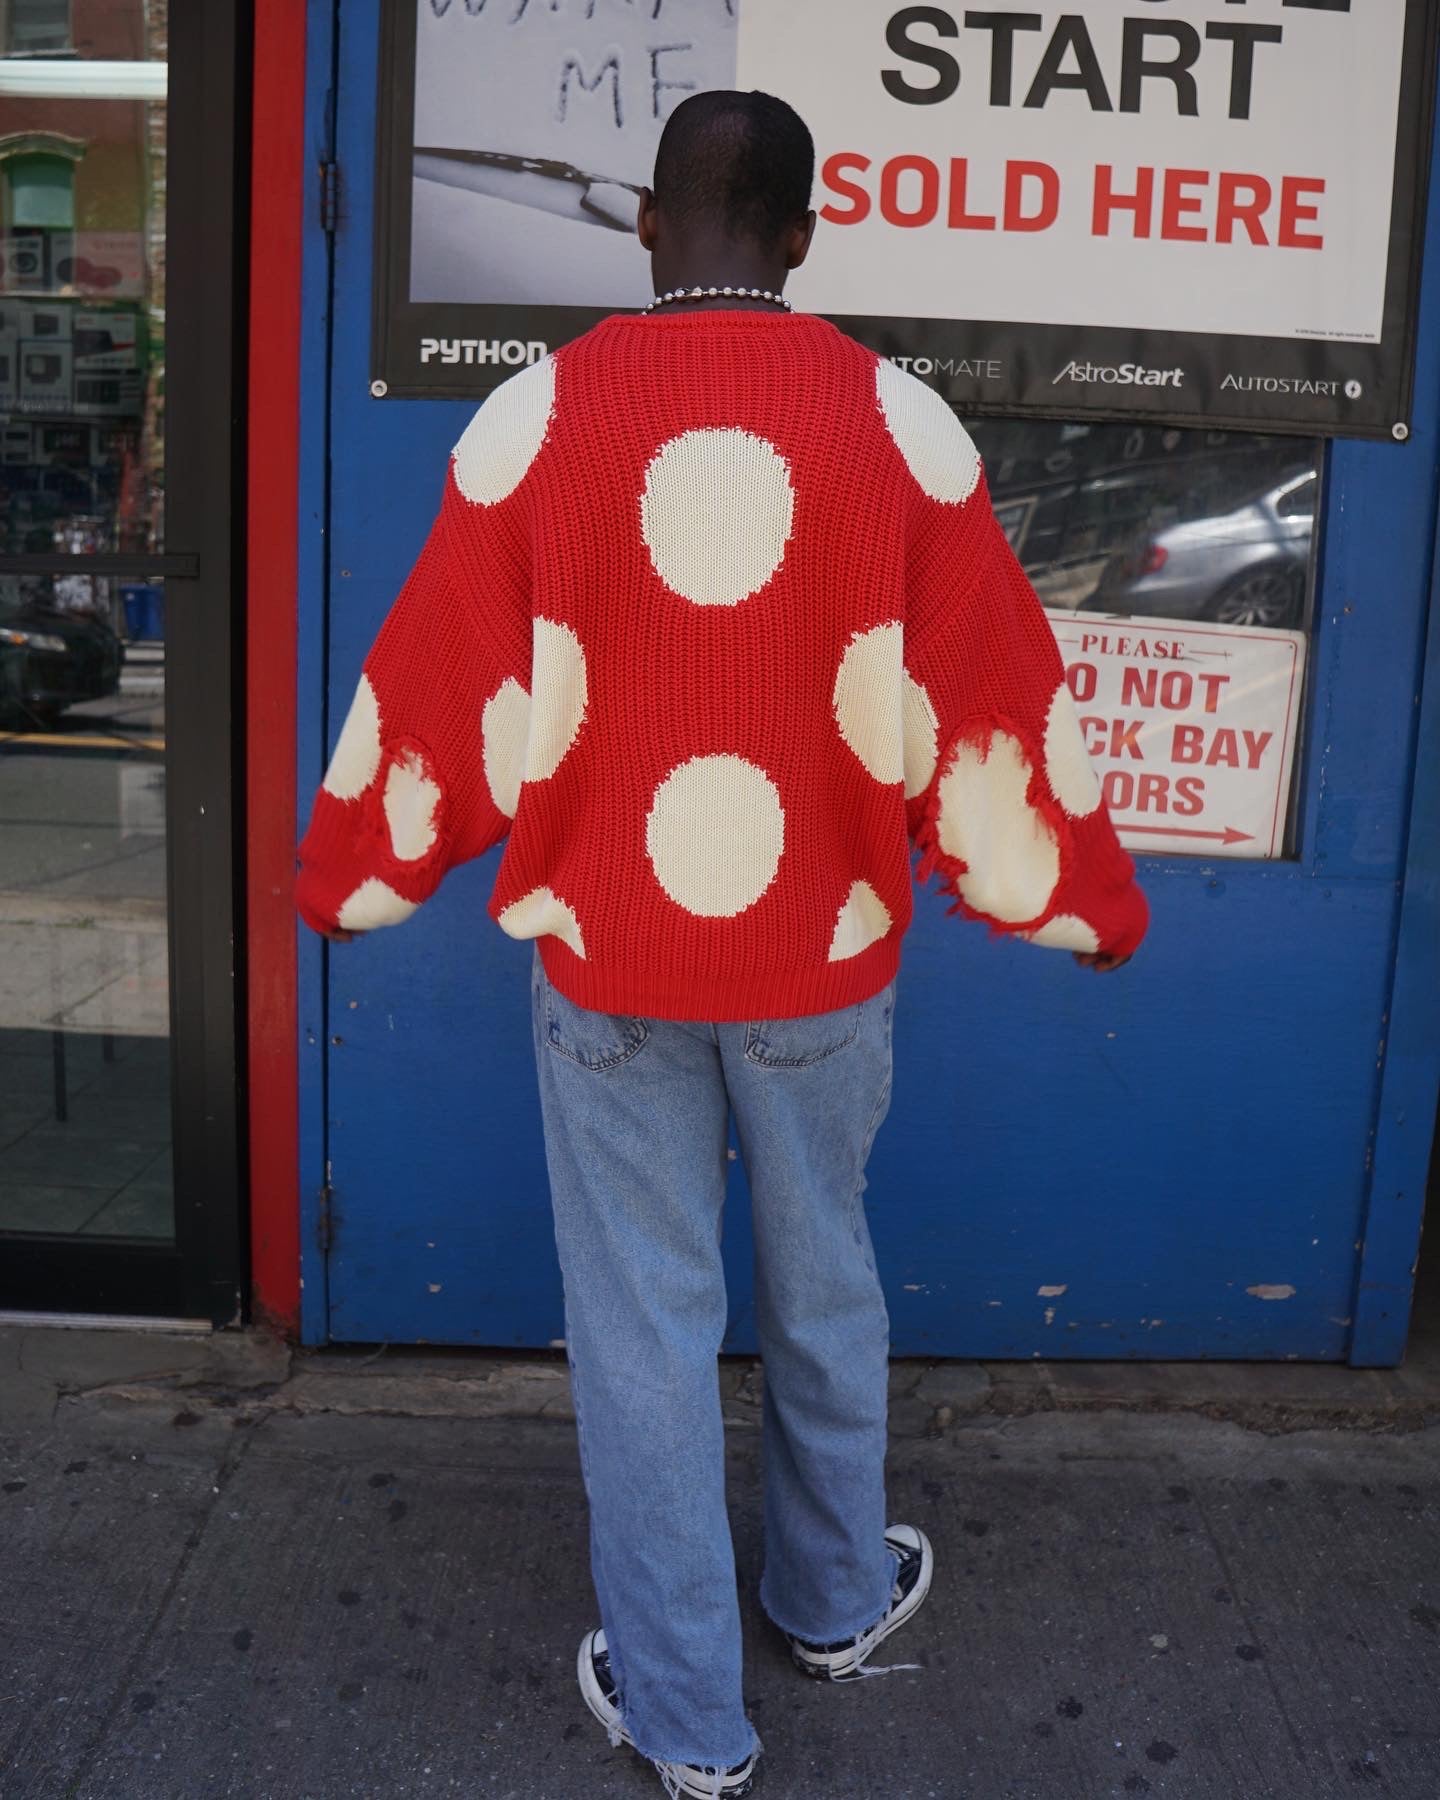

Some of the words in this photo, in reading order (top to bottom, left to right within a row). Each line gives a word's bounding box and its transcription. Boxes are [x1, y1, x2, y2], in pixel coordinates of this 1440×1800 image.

[881, 6, 1283, 120] START
[819, 152, 1060, 232] SOLD
[1091, 164, 1326, 250] HERE
[420, 338, 548, 366] PYTHON
[1052, 361, 1184, 387] AstroStart
[1220, 374, 1340, 396] AUTOSTART
[1081, 634, 1185, 660] PLEASE
[1066, 662, 1097, 703] O
[1121, 667, 1230, 713] NOT
[1171, 724, 1273, 769] BAY
